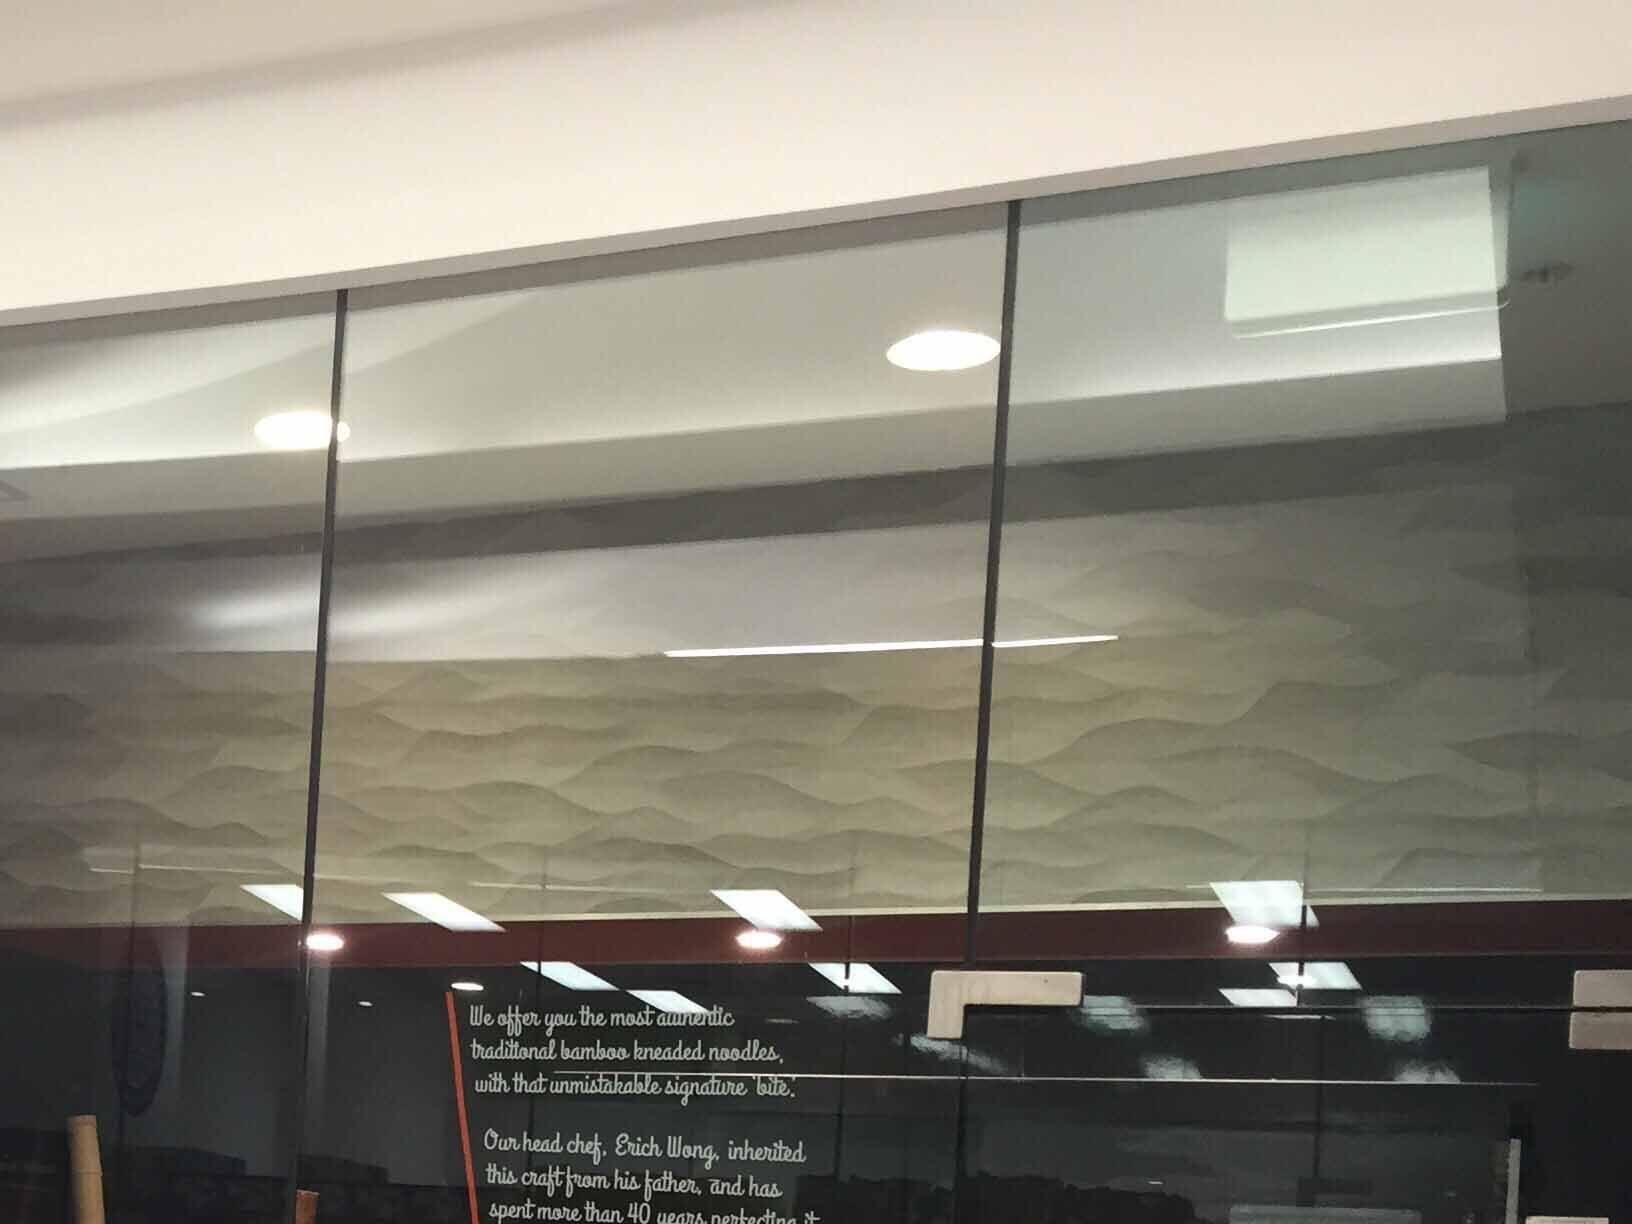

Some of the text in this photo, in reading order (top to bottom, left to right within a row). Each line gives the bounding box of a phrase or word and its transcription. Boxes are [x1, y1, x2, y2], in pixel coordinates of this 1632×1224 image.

[470, 1005, 494, 1025] We
[497, 1005, 541, 1036] offer
[545, 1011, 577, 1036] you
[579, 1005, 606, 1025] the
[610, 1007, 655, 1026] most
[471, 1038, 557, 1060] traditional
[561, 1040, 630, 1060] bamboo
[634, 1040, 706, 1061] kneaded
[475, 1072, 510, 1094] with
[512, 1073, 549, 1094] that
[550, 1073, 662, 1096] unmistakable
[664, 1075, 748, 1106] signature
[484, 1128, 520, 1151] Our
[523, 1132, 563, 1153] head
[616, 1133, 663, 1157] Erich
[728, 1140, 807, 1163] inherited
[485, 1163, 517, 1185] this
[521, 1166, 565, 1197] craft
[565, 1171, 610, 1198] from
[614, 1169, 641, 1190] his
[708, 1176, 745, 1197] and
[748, 1177, 783, 1198] has
[537, 1203, 582, 1222] more
[584, 1201, 624, 1224] than
[627, 1202, 651, 1224] 40
